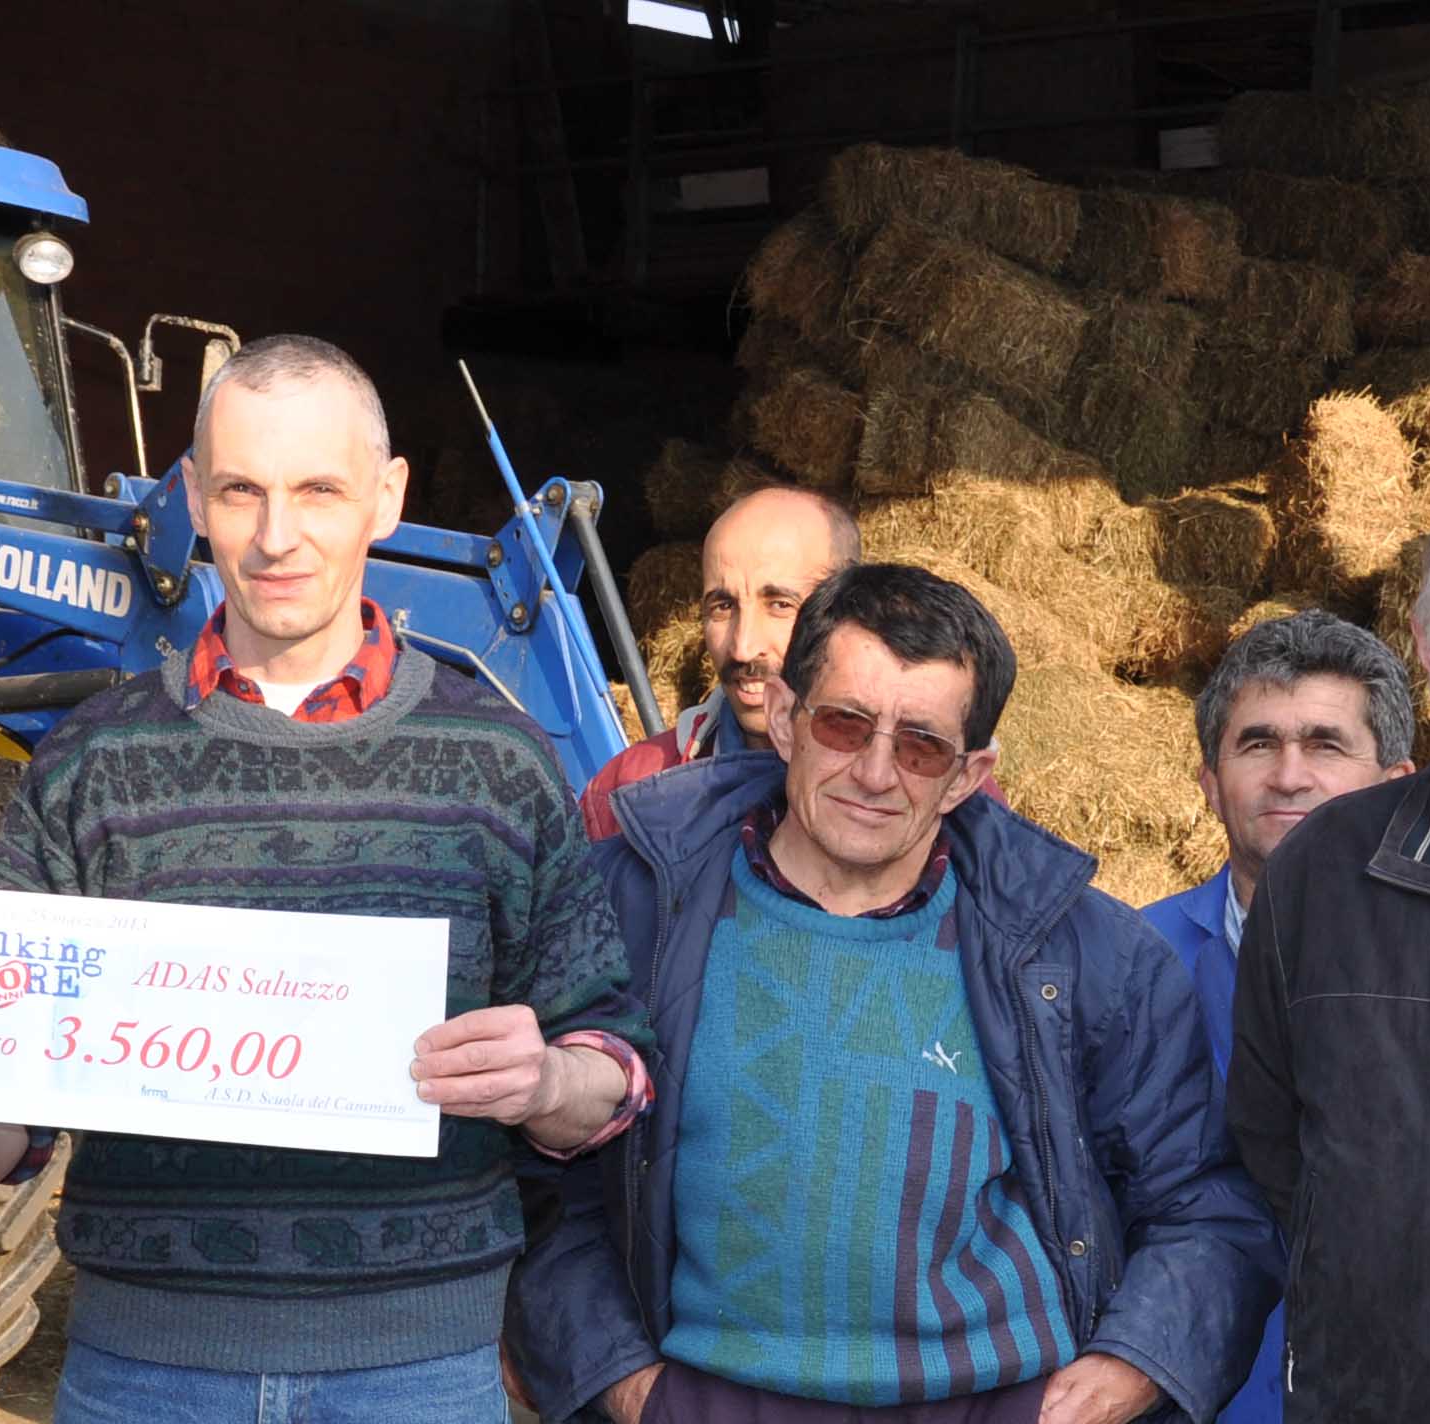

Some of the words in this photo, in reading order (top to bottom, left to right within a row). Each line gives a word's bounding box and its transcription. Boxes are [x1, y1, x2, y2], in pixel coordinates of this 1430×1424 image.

[132, 961, 230, 994] ADAS
[238, 967, 351, 1001] Saluzzo
[44, 1015, 303, 1083] 3.560,00
[308, 1096, 331, 1111] del
